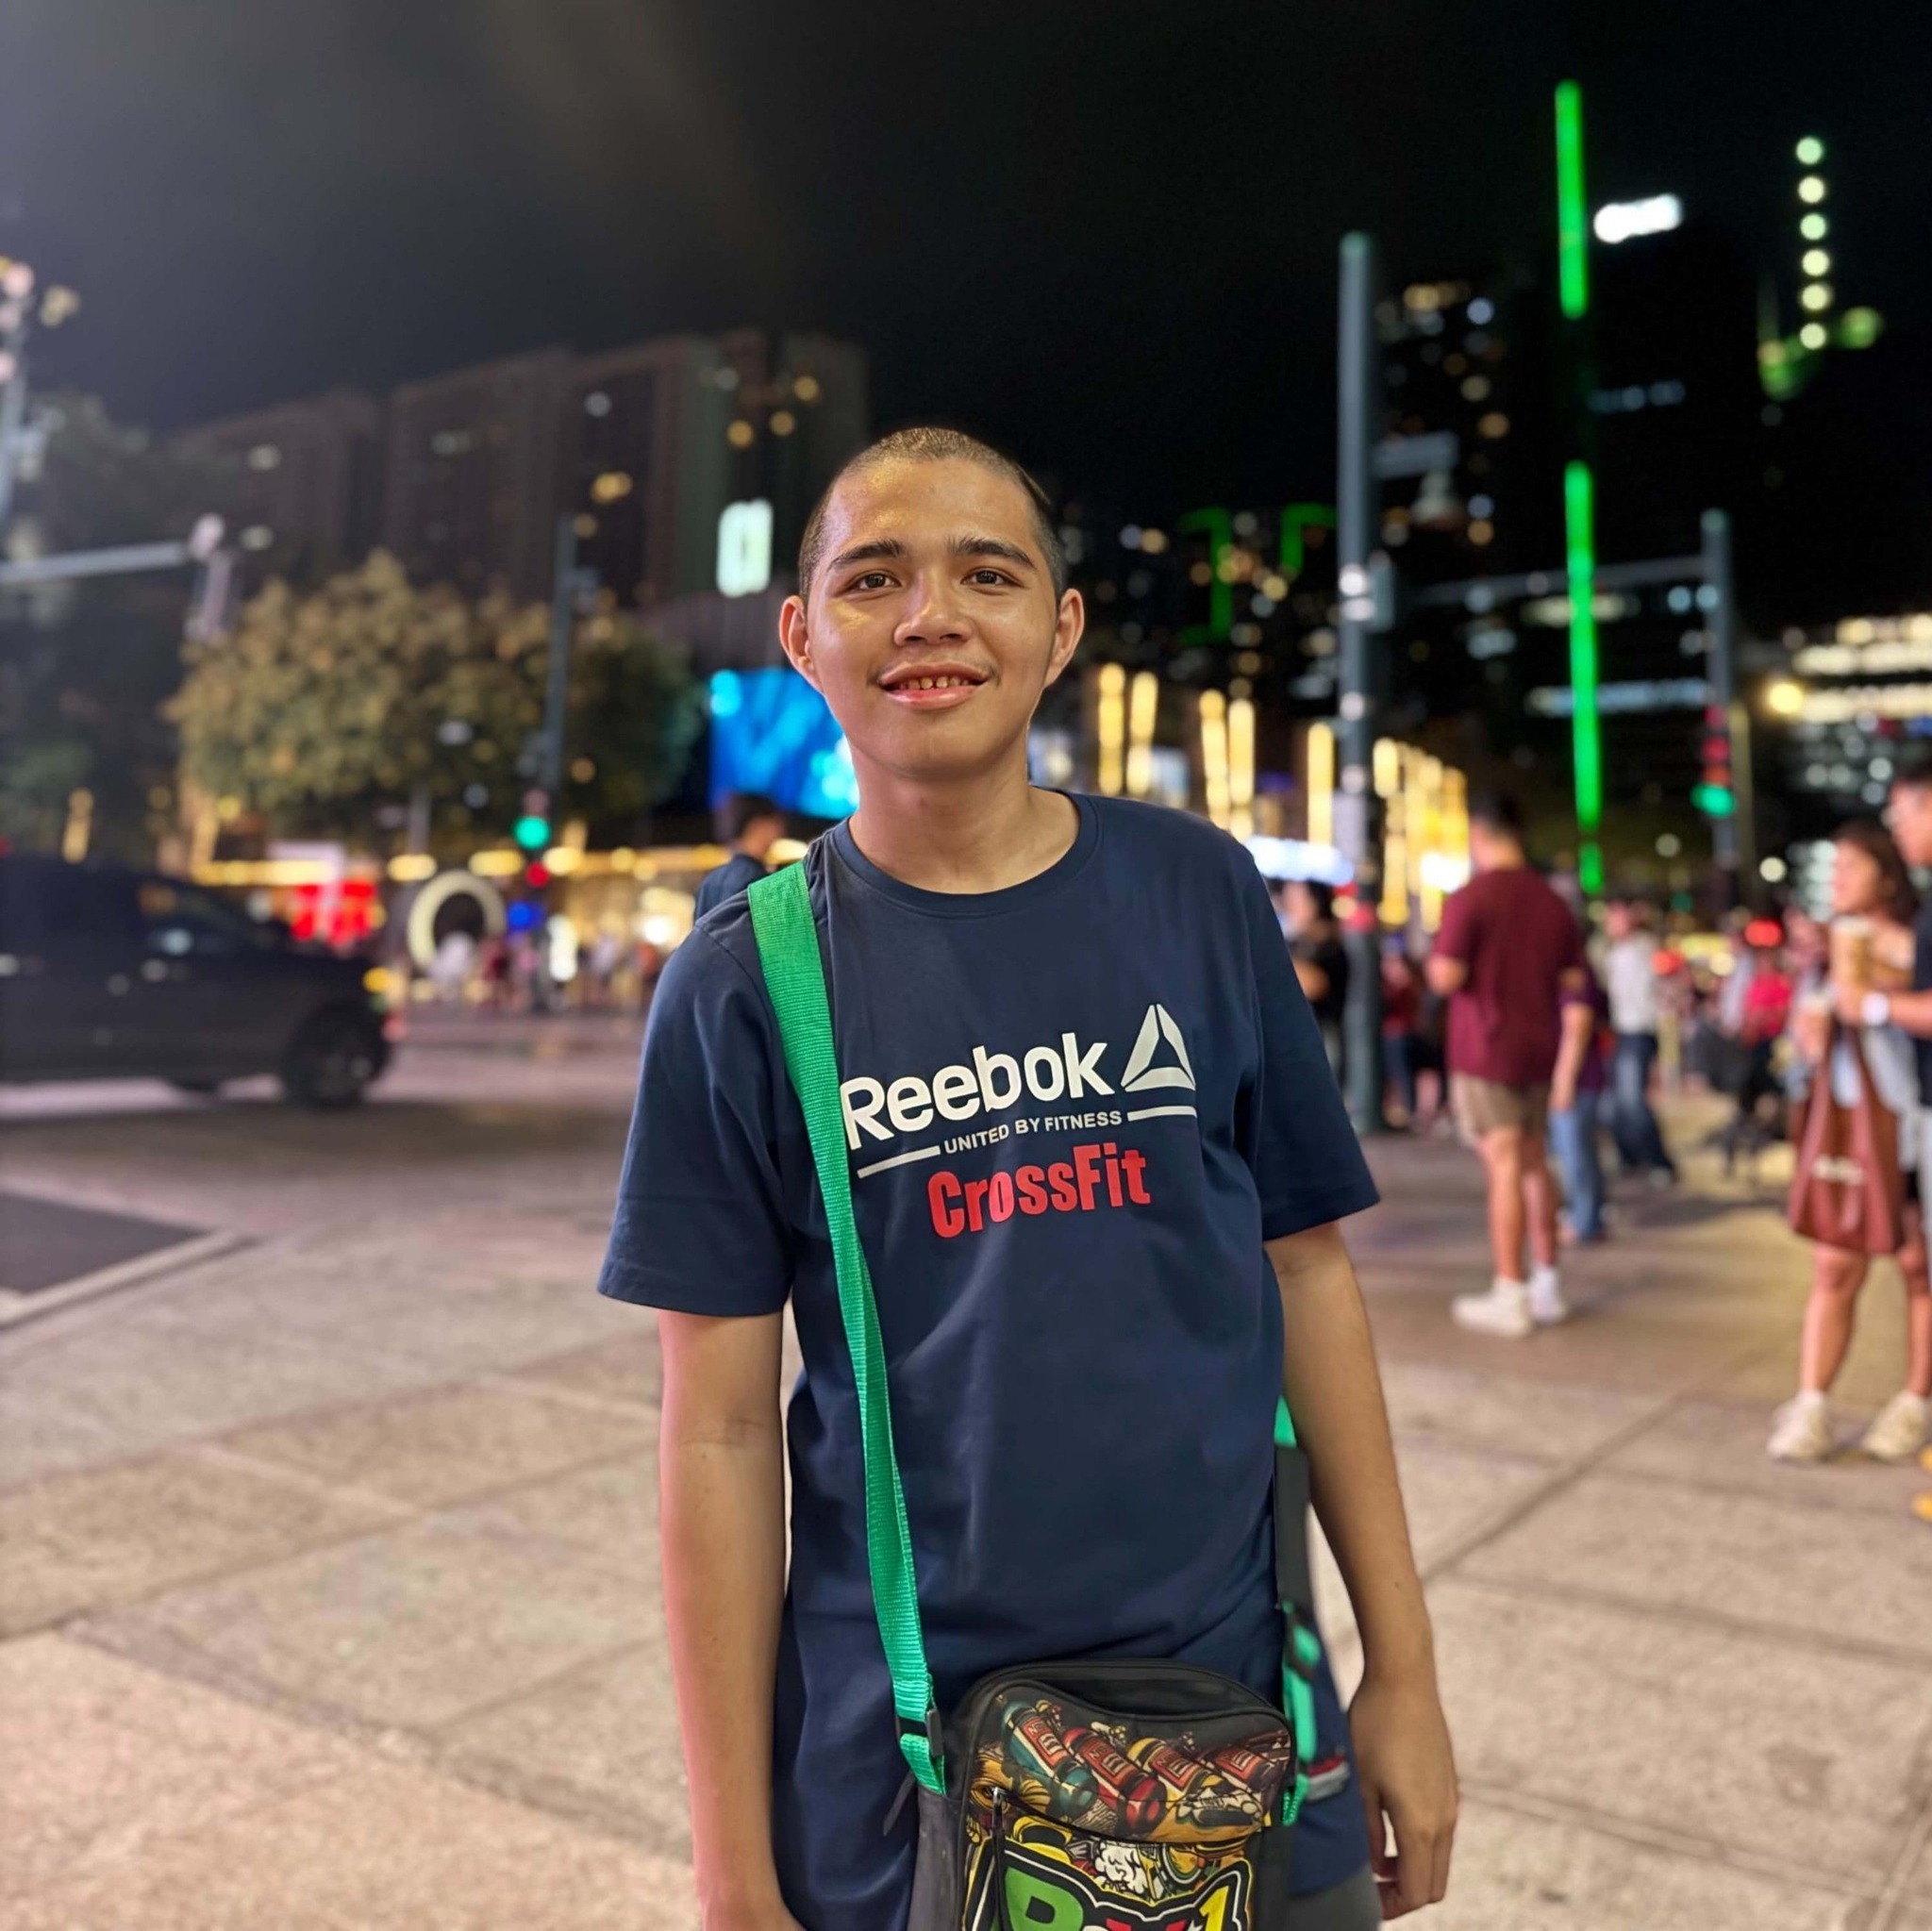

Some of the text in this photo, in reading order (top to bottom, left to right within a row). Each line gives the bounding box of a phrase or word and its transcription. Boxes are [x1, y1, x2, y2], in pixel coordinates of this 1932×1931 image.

[839, 1032, 1115, 1151] Reebok
[943, 1110, 1123, 1155] UNITED BY FITNESS
[927, 1141, 1151, 1239] CrossFit
